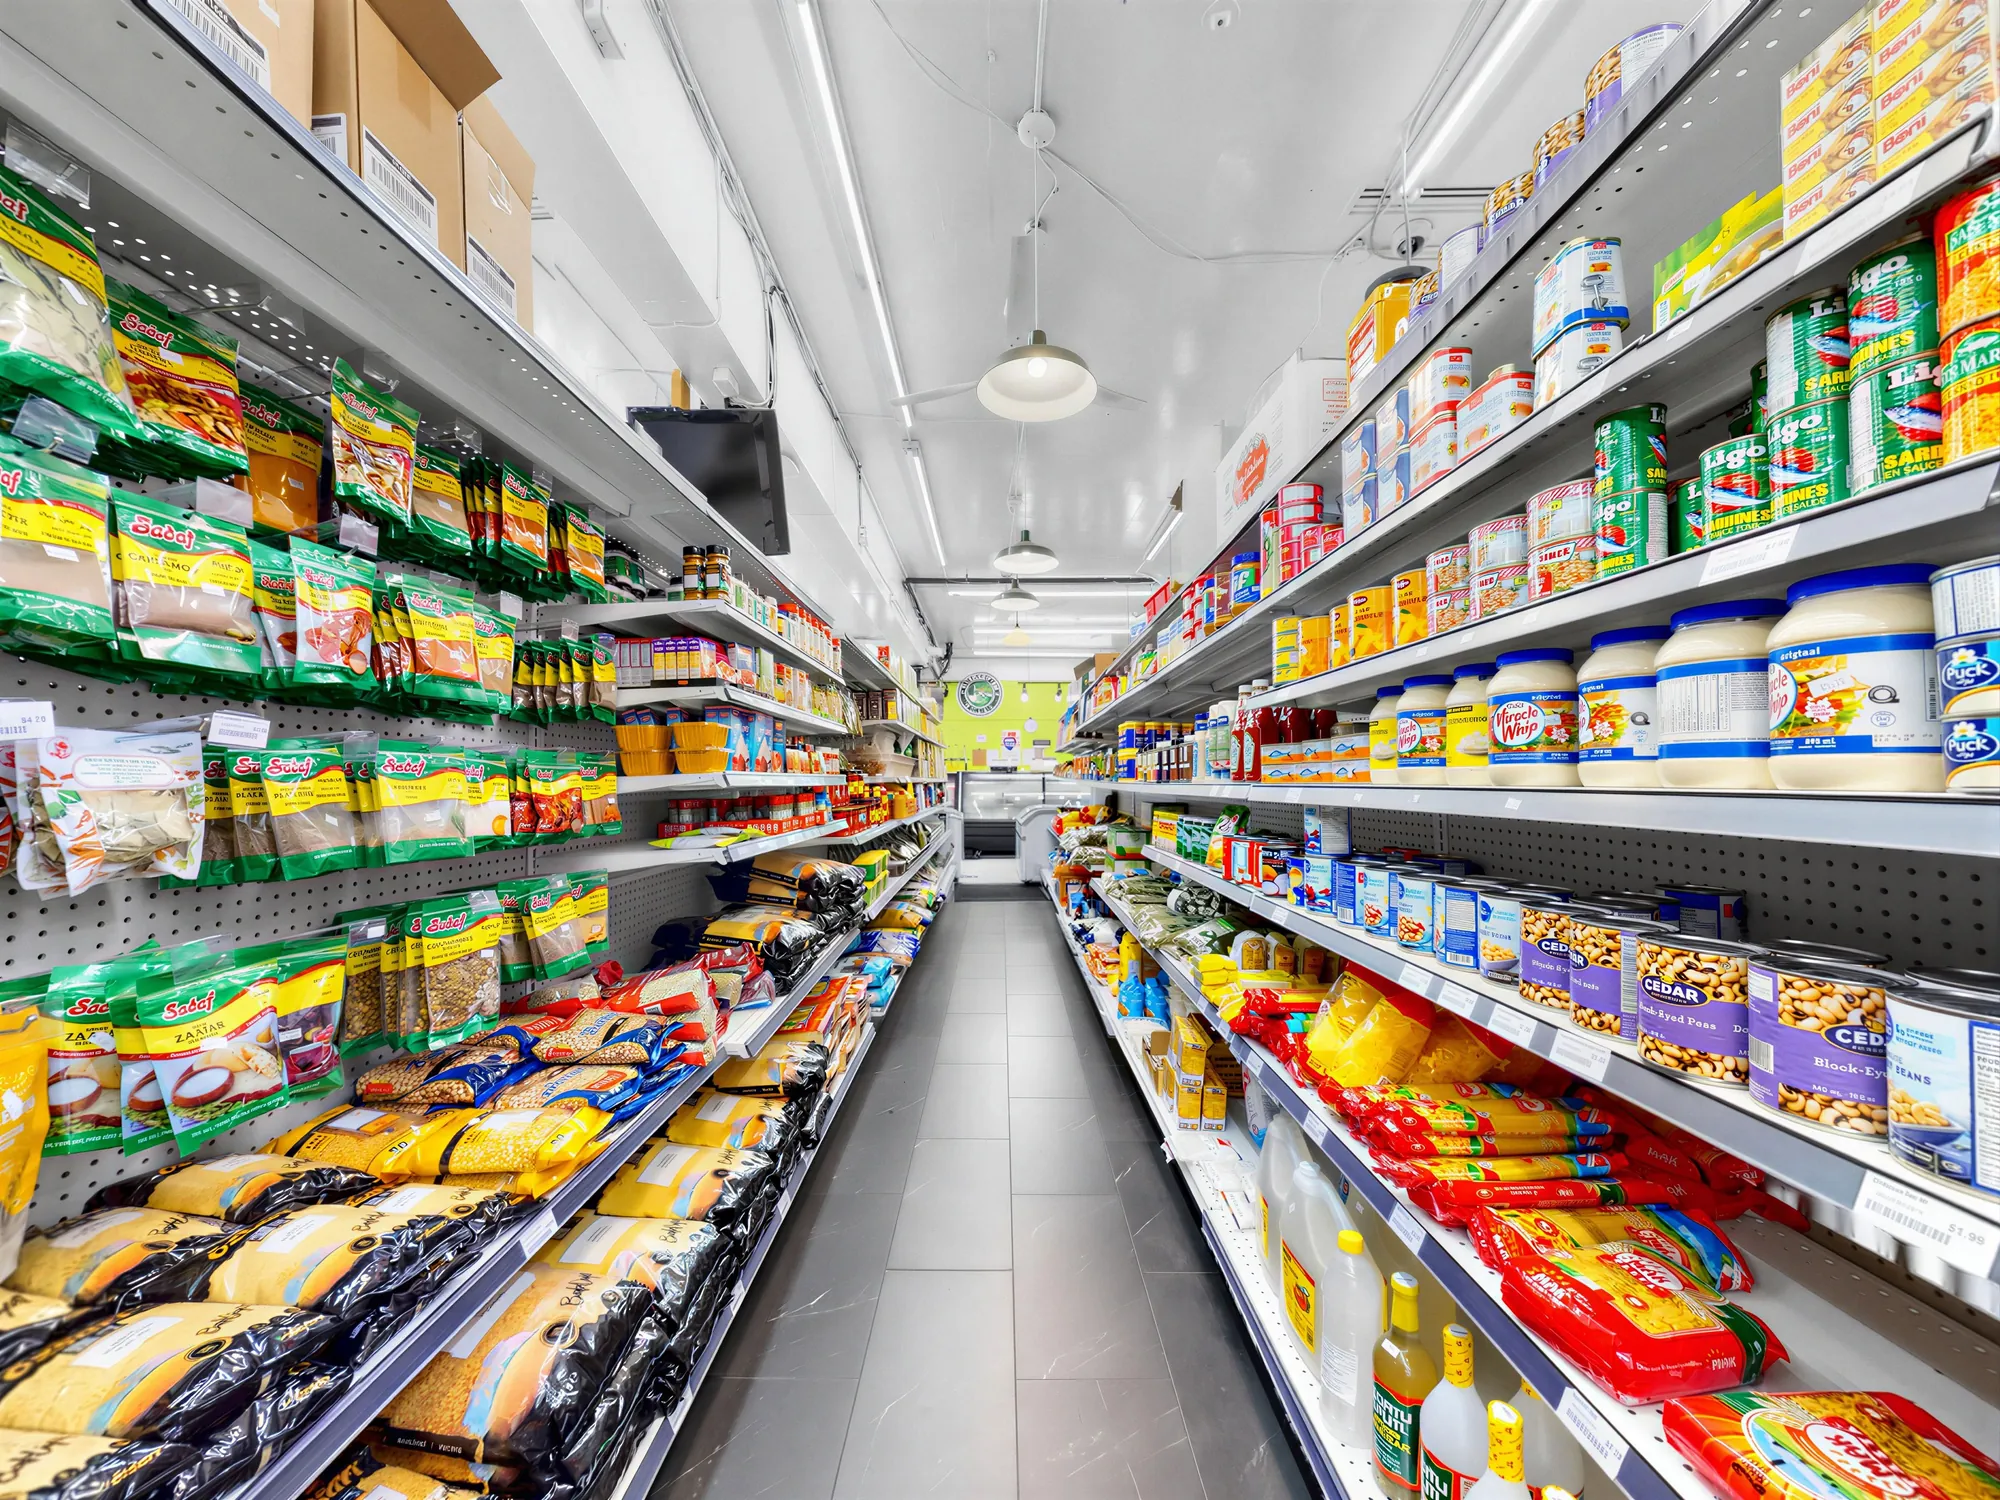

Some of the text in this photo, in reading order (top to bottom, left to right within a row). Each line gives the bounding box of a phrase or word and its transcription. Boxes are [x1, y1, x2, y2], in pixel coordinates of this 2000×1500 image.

[1880, 21, 1921, 66] Beni
[1786, 60, 1820, 100] Beni
[1881, 68, 1923, 112] Beni
[1787, 102, 1820, 140] Beni
[1883, 112, 1926, 155] Beni
[1788, 144, 1822, 180] Beni
[1789, 186, 1822, 221] Beni
[130, 513, 196, 550] Sadaf
[1947, 661, 1992, 683] Puck
[1950, 736, 1992, 752] Puck
[1644, 979, 1699, 1004] CEDAR
[1687, 1016, 1717, 1031] Peas
[1947, 1223, 1985, 1246] $1.99
